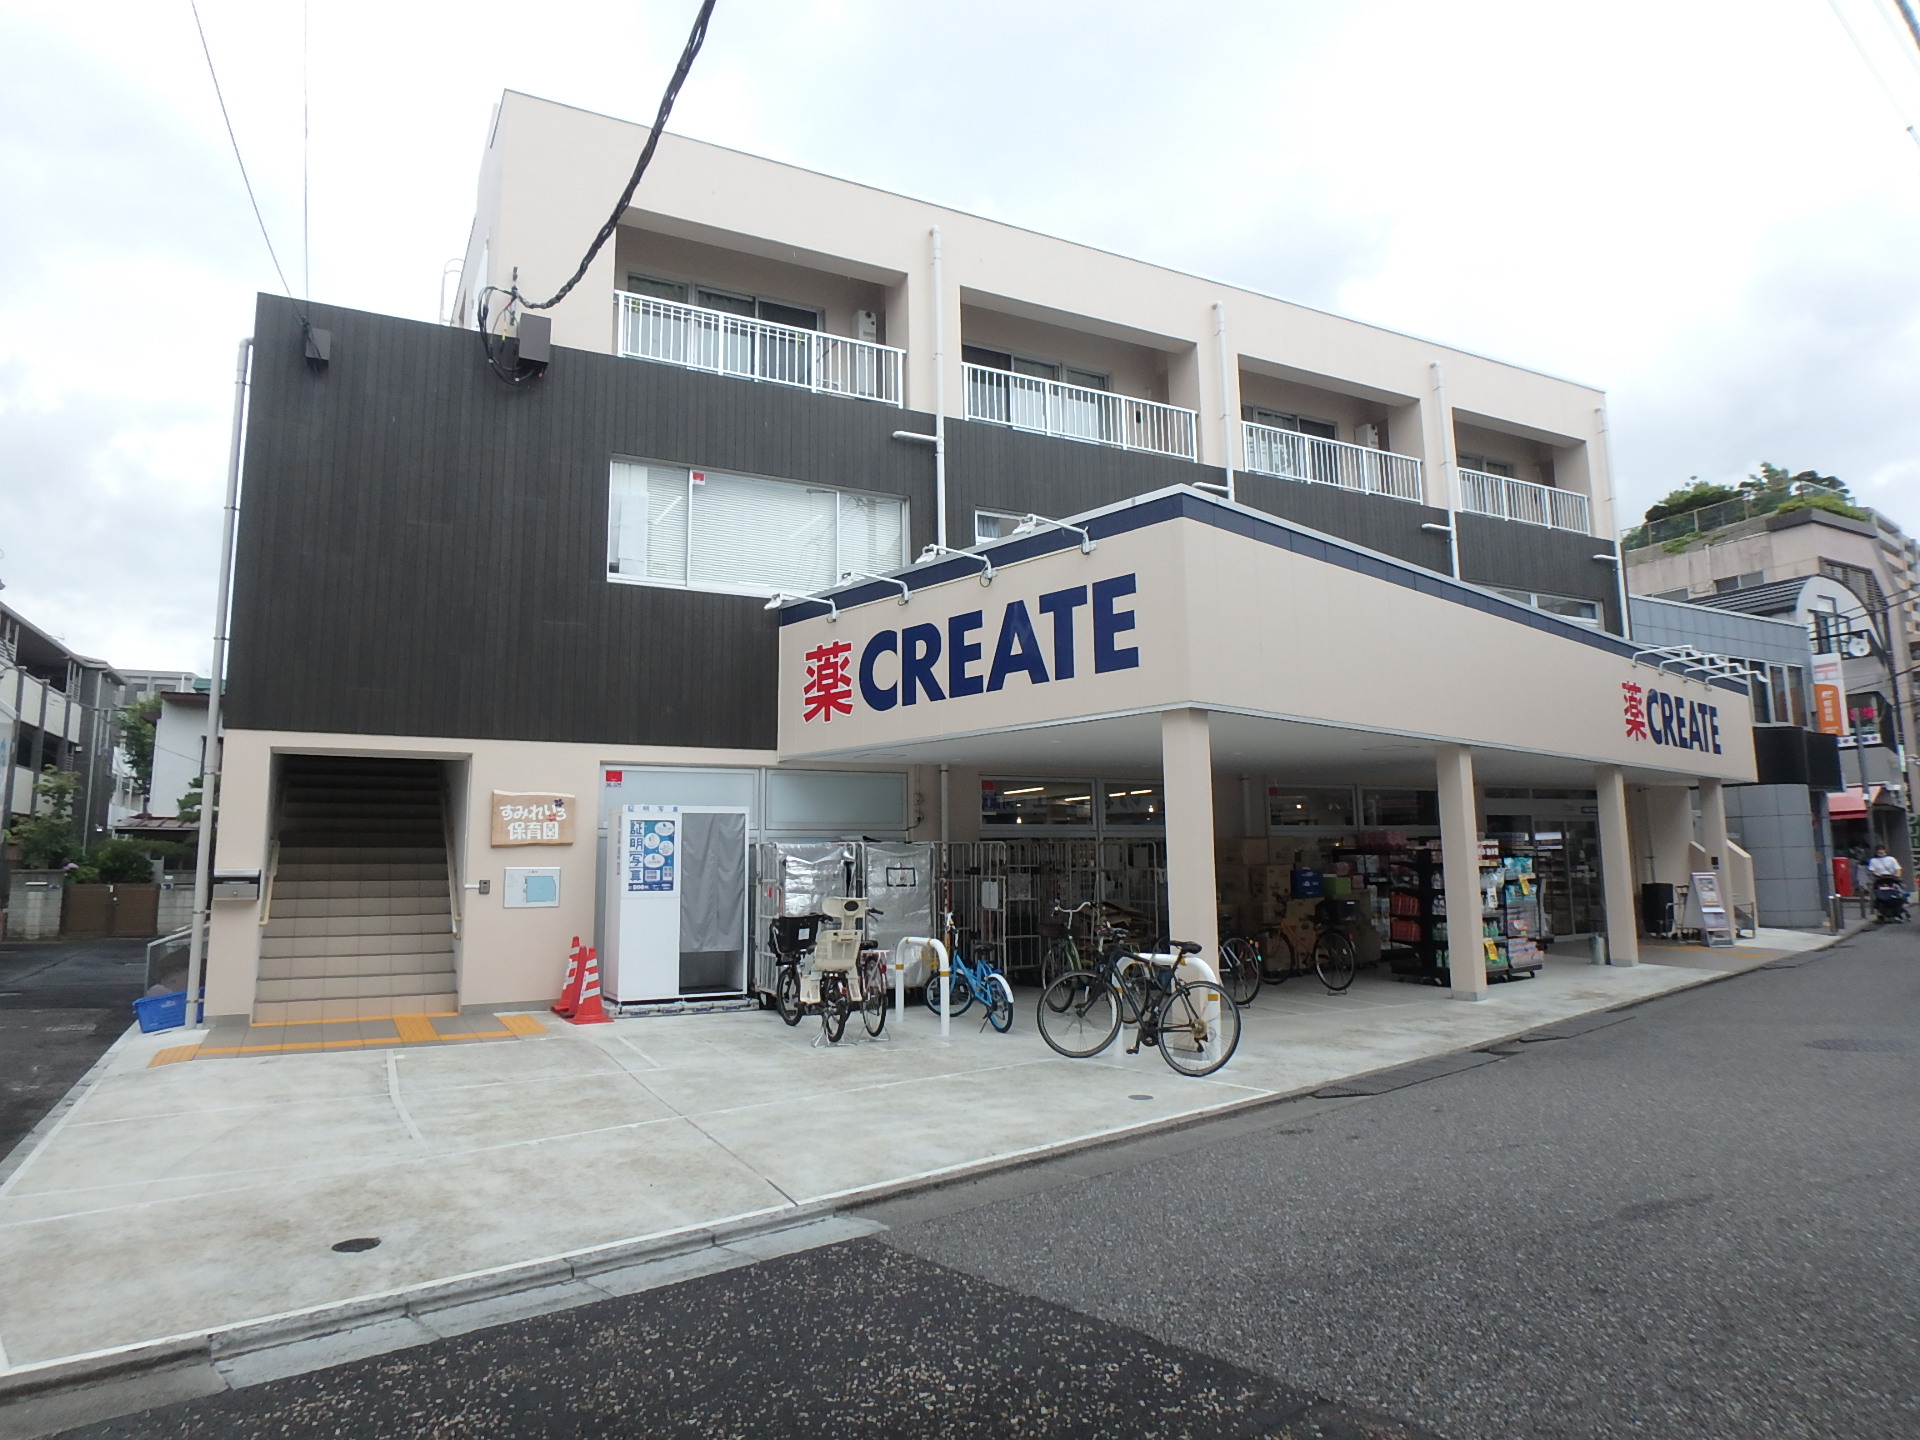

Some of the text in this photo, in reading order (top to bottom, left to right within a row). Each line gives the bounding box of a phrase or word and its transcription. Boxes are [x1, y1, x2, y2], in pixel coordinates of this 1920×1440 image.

[803, 573, 1140, 723] 薬 CREATE
[1621, 681, 1722, 755] 薬 CREATE
[500, 804, 567, 821] すみれいろ
[507, 821, 559, 840] 保育園
